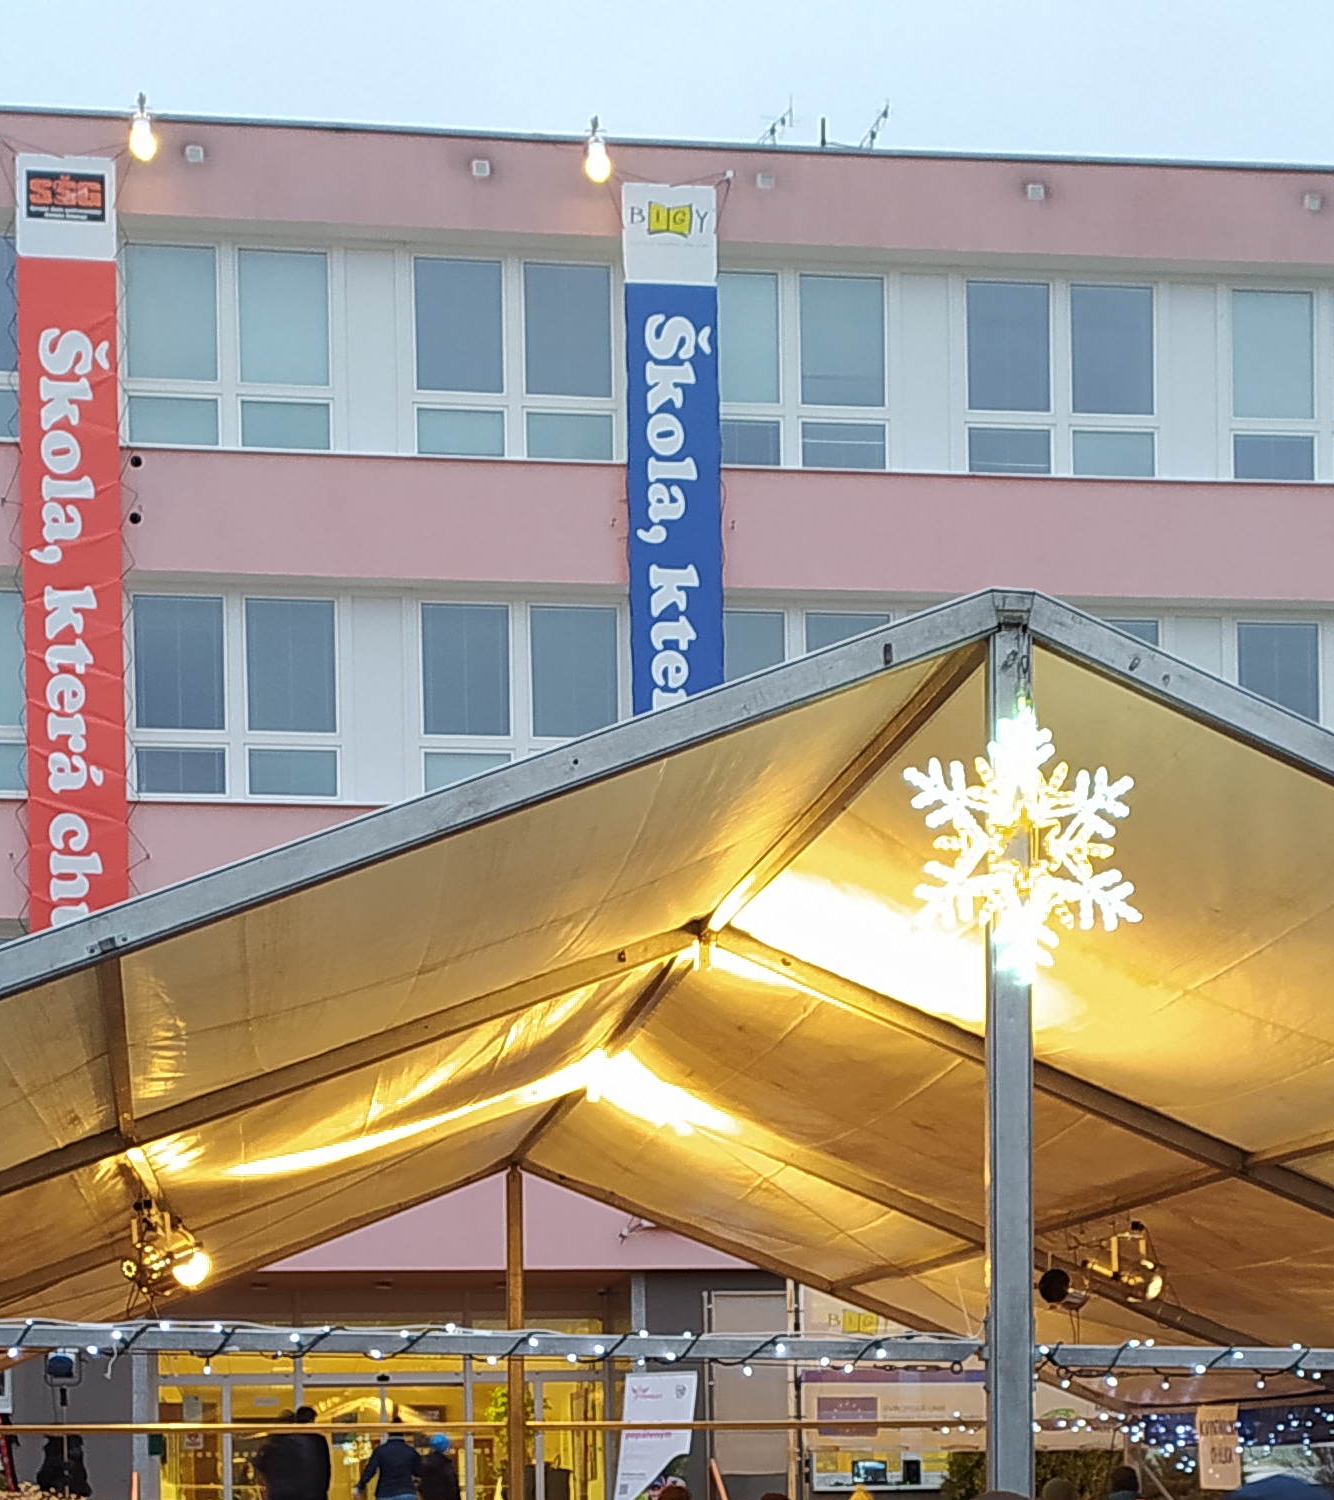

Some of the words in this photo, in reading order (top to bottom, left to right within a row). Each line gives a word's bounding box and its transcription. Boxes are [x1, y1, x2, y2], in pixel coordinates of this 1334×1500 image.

[629, 204, 709, 234] BIGY
[29, 327, 110, 565] Škola,
[636, 313, 712, 545] Škola,
[43, 585, 104, 794] která
